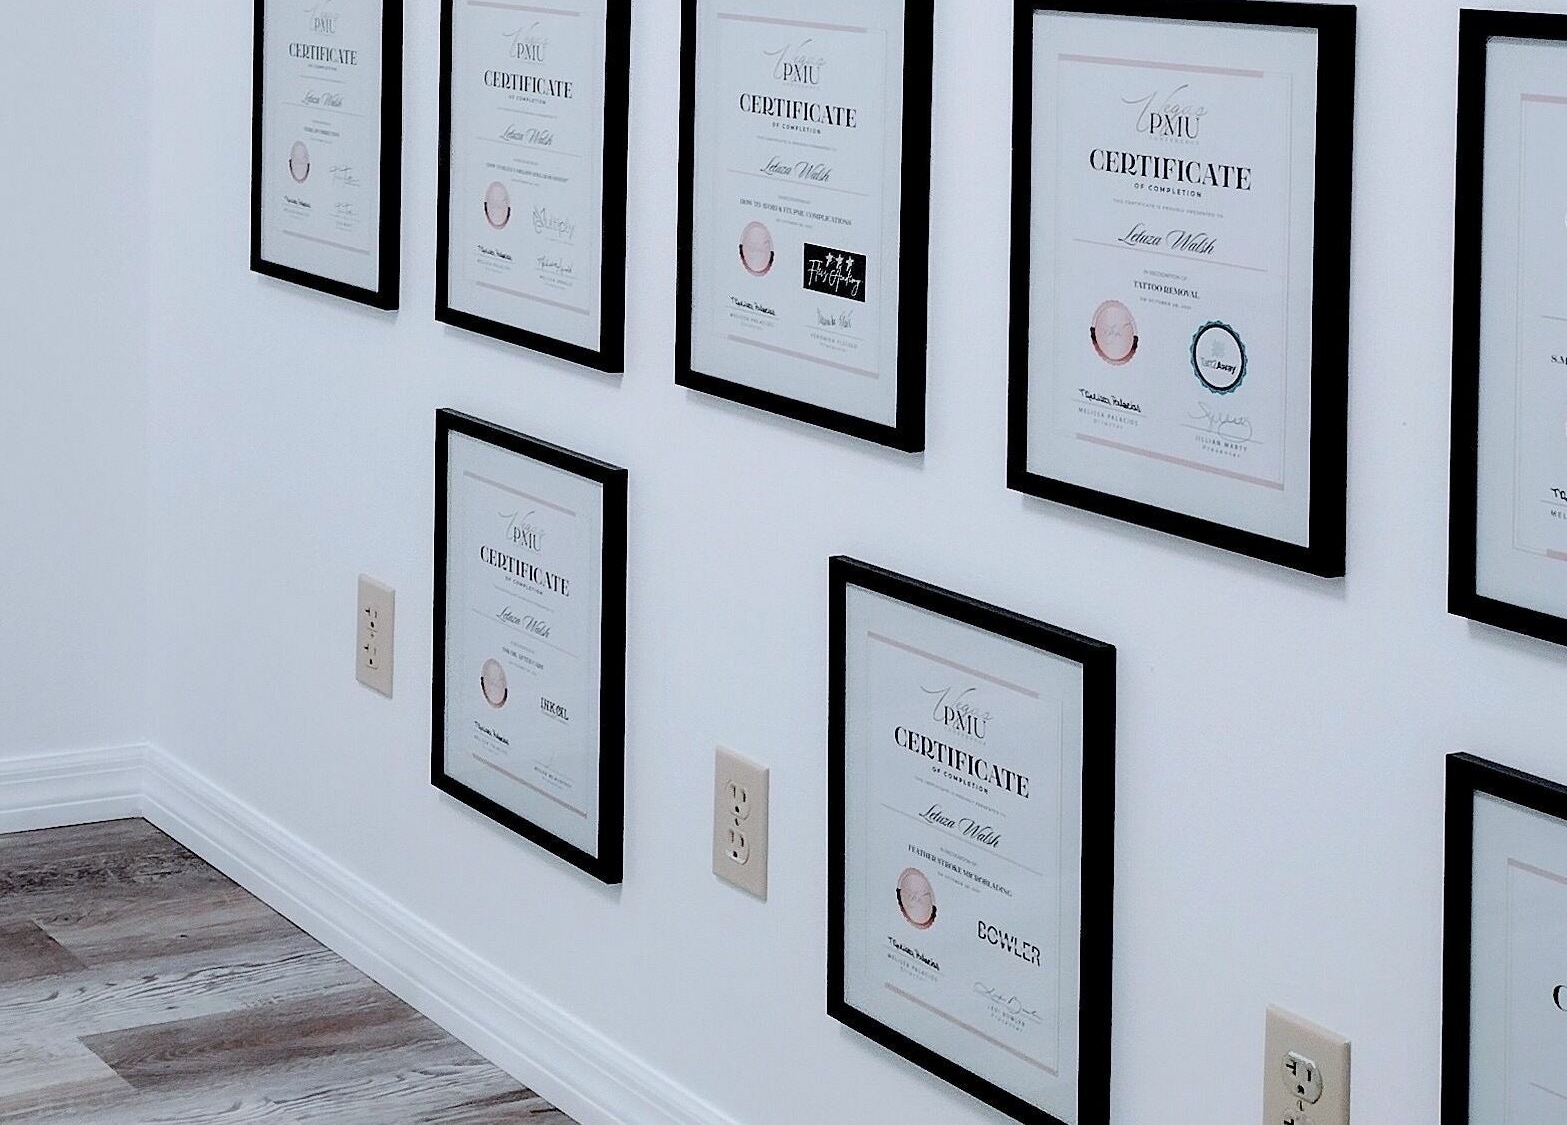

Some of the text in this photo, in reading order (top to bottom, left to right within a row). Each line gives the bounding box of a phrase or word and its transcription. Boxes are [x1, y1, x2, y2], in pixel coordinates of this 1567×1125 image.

[289, 42, 358, 66] CERTIFICATE
[516, 41, 545, 63] PMU
[484, 69, 573, 100] CERTIFICATE
[783, 62, 820, 85] PMU
[739, 92, 857, 128] CERTIFICATE
[1121, 84, 1209, 133] Vegas
[782, 123, 821, 135] COMPLETION
[1150, 112, 1200, 139] PMU
[794, 161, 832, 183] Walsh
[1089, 148, 1252, 191] CERTIFICATE
[1134, 182, 1202, 198] OF COMPLETION
[1165, 229, 1218, 255] Walsh
[1134, 280, 1200, 300] TATTOO REMOVAL
[513, 526, 542, 552] PMU
[480, 545, 570, 597] CERTIFICATE
[920, 685, 994, 722] Vegas
[943, 706, 987, 739] PMU
[895, 726, 1029, 799] CERTIFICATE
[944, 771, 988, 794] COMPLETION
[959, 818, 1002, 848] Walsh
[908, 844, 936, 862] FEATHER
[978, 920, 1040, 966] BOWLER
